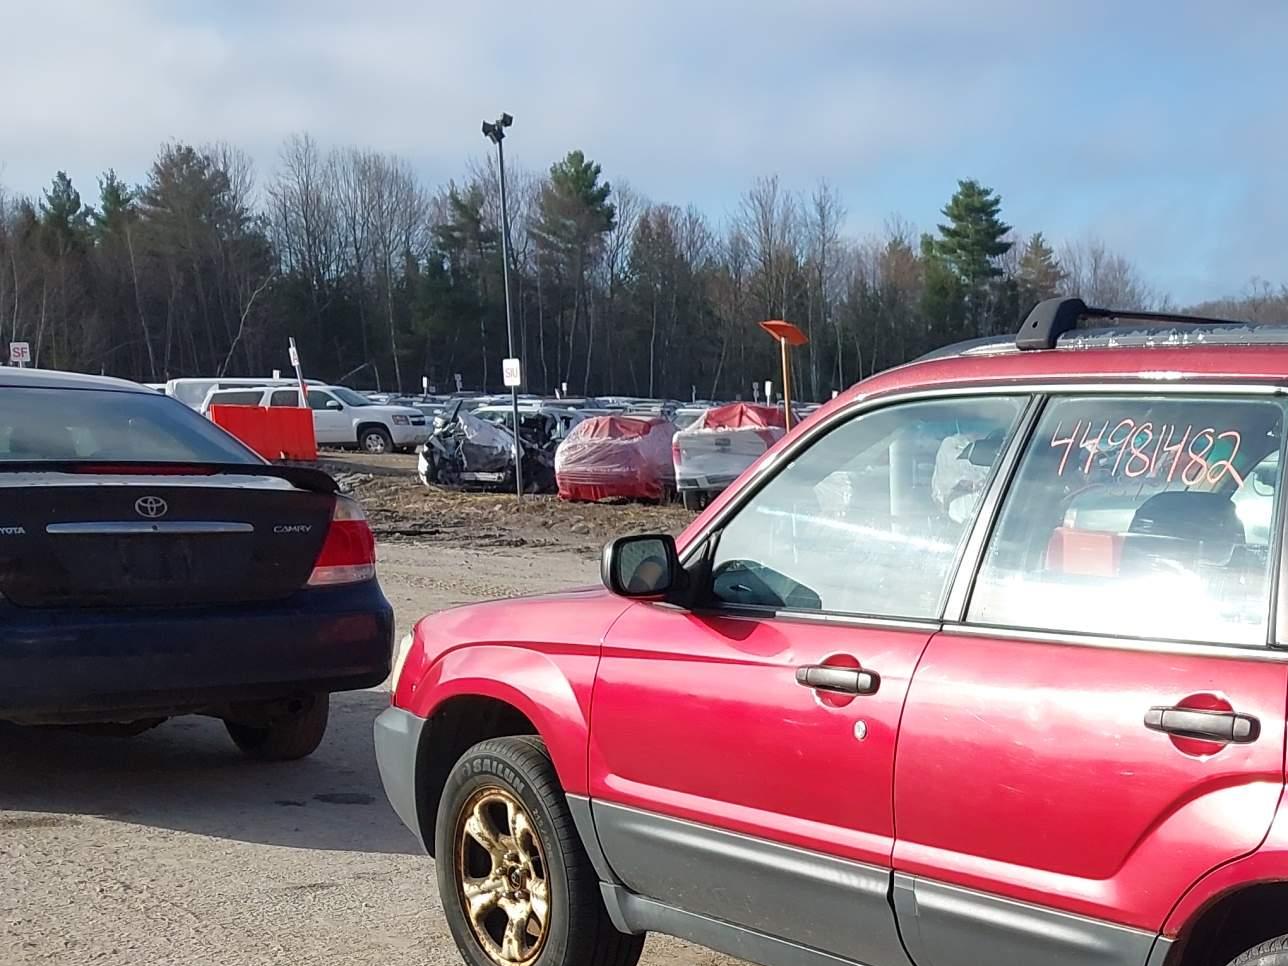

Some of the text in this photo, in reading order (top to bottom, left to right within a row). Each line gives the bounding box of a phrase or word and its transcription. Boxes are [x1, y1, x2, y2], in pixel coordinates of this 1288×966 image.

[13, 347, 27, 357] SF
[505, 367, 518, 378] SIU
[1051, 418, 1244, 488] 44981482
[273, 524, 312, 533] CAMRY
[473, 759, 525, 792] SAILUN
